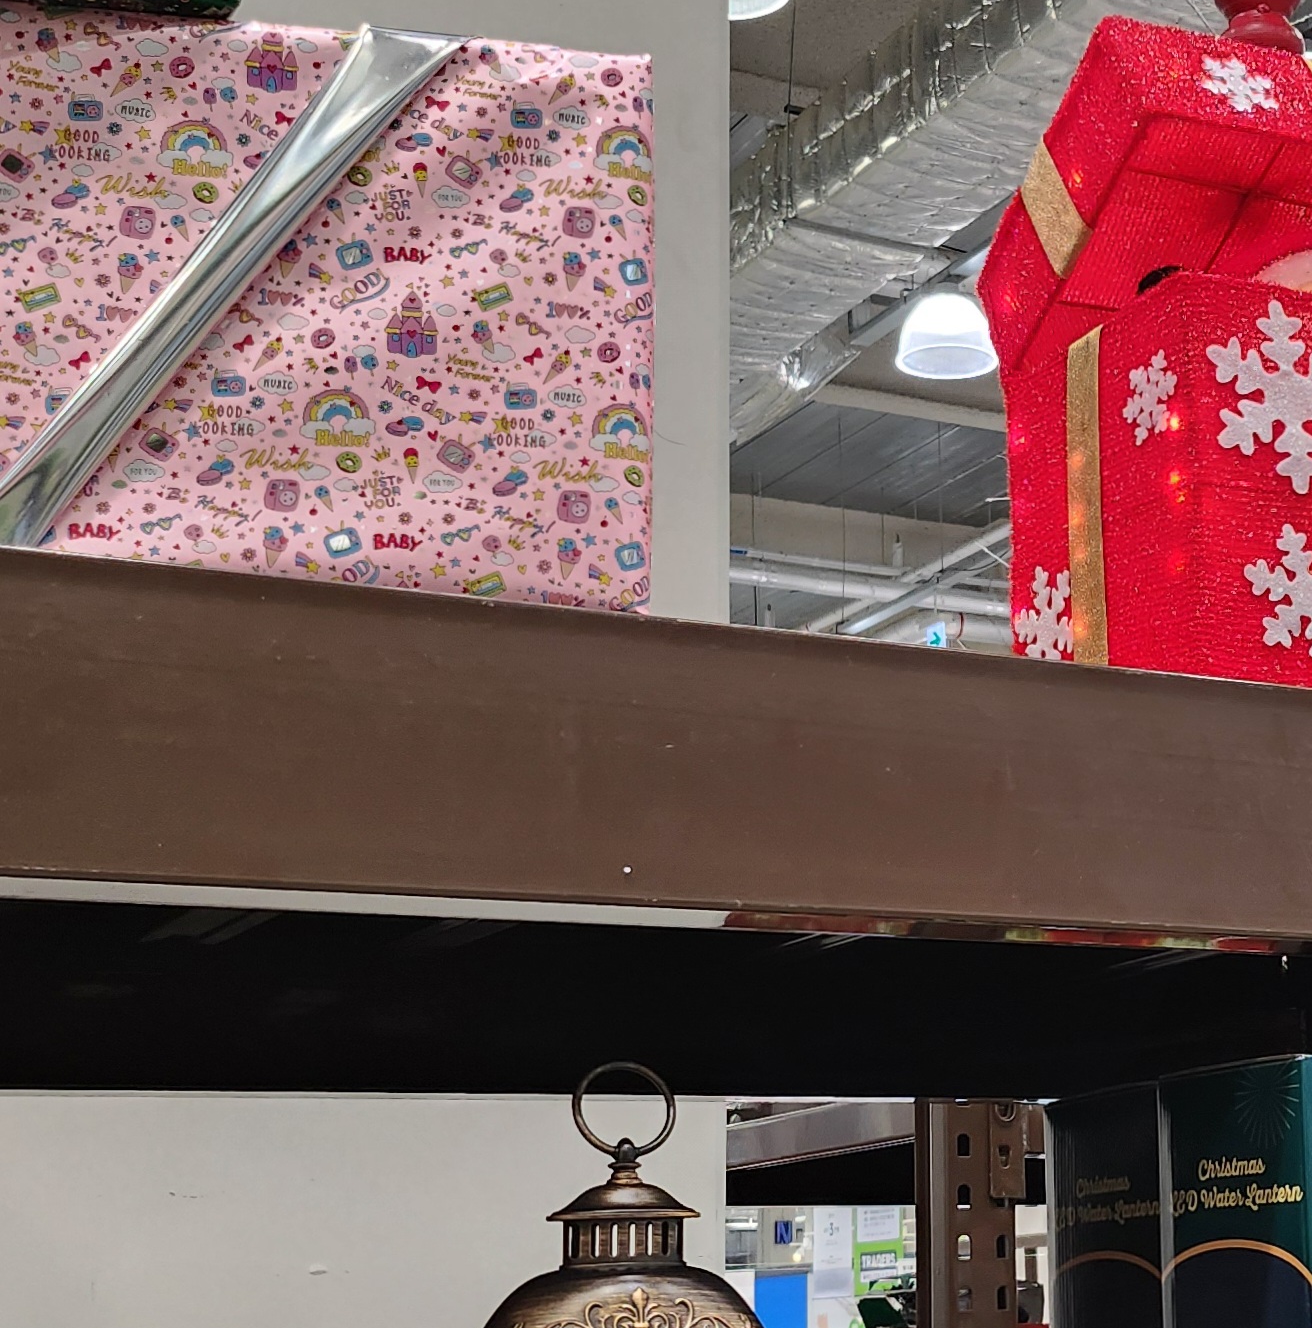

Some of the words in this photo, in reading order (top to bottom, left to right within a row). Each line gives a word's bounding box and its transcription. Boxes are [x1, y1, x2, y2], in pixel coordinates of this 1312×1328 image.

[120, 105, 151, 118] MUSIC
[558, 113, 586, 125] MUSIC
[239, 109, 279, 141] Nice
[64, 129, 100, 143] GOOD
[507, 136, 540, 150] GOOD
[172, 158, 228, 179] Hello!
[97, 173, 169, 199] Wish
[371, 188, 406, 202] JUST
[539, 178, 606, 201] Wish
[382, 199, 410, 212] FOR
[384, 246, 432, 264] BABY
[263, 378, 293, 390] MUSIC
[381, 376, 420, 406] Nice
[422, 399, 456, 425] day
[553, 391, 582, 404] MUSIC
[207, 404, 243, 419] GOOD
[501, 417, 535, 431] GOOD
[315, 427, 371, 448] Hello!
[240, 447, 314, 471] Wish
[533, 457, 603, 483] Wish
[360, 475, 396, 490] JUST
[372, 486, 401, 499] FOR
[68, 523, 121, 540] BABY
[373, 532, 424, 552] BABY
[1198, 1155, 1265, 1181] Christmas
[1076, 1175, 1131, 1198] Christmas
[1200, 1185, 1243, 1209] Water
[1244, 1183, 1303, 1211] Lantern
[1079, 1204, 1112, 1224] Water
[1114, 1199, 1160, 1225] Lantern
